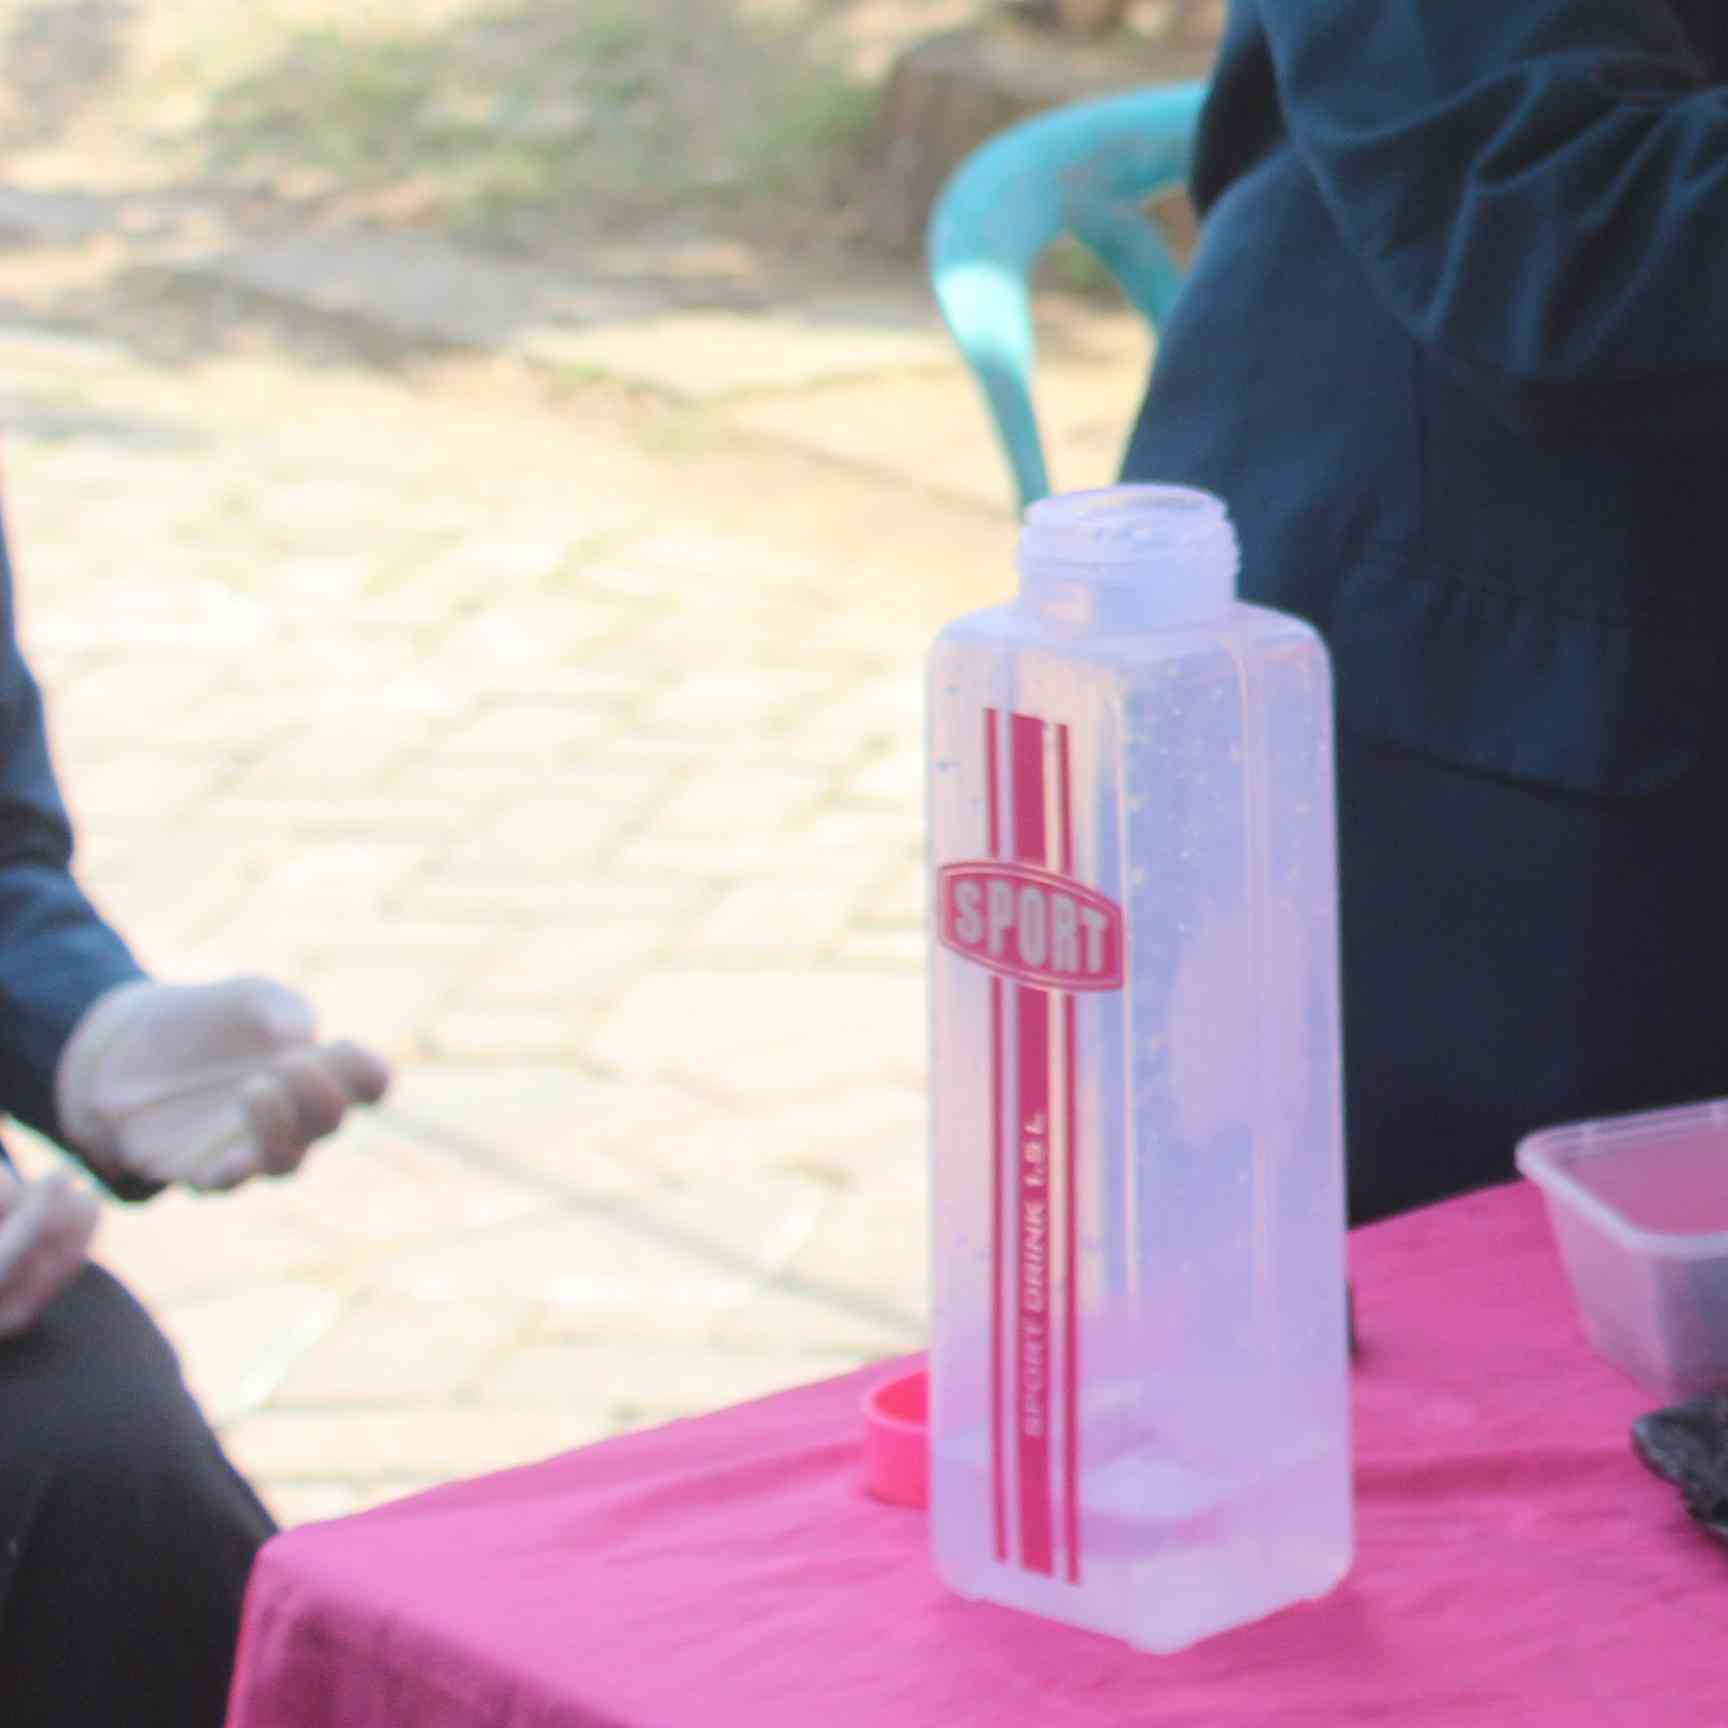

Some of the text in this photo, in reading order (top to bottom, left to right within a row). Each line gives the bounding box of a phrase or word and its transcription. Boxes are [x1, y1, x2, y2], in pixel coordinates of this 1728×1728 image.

[954, 879, 1108, 972] SPORT
[1022, 1200, 1044, 1313] DRINK
[1022, 1315, 1043, 1437] SPORT
